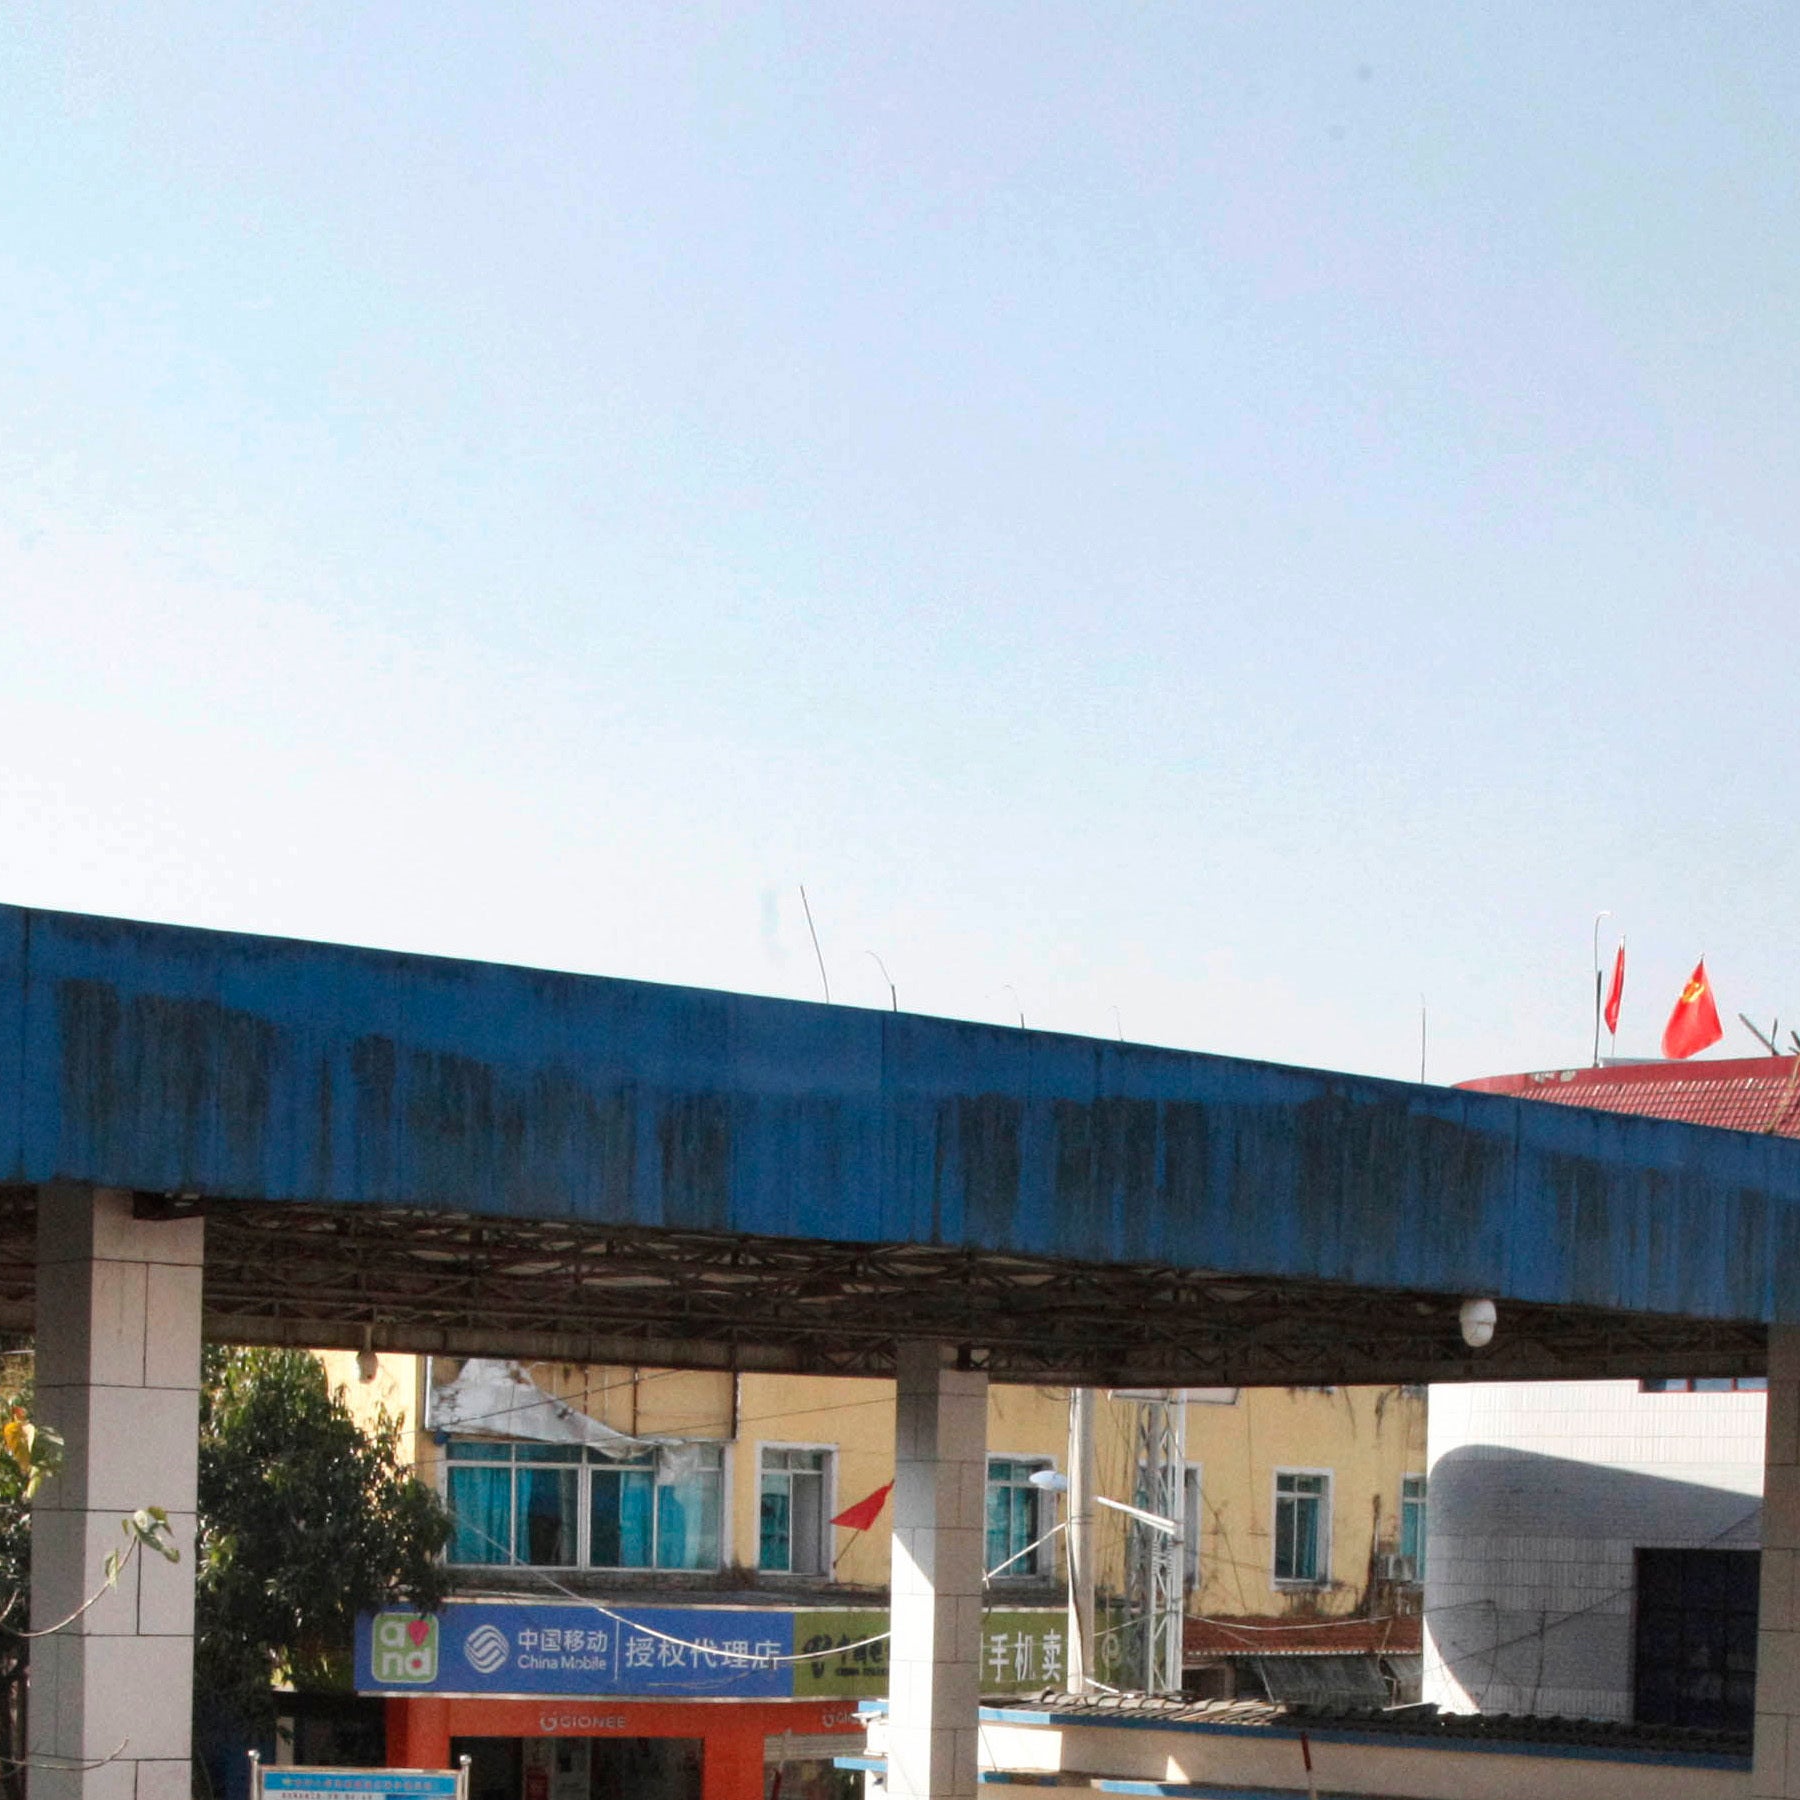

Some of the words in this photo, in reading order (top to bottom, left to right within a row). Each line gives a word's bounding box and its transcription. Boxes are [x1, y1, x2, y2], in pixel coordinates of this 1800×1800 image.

[517, 1628, 608, 1653] 中国移动
[625, 1636, 782, 1670] 授权代理店
[517, 1654, 558, 1670] China
[561, 1656, 606, 1671] Mobile
[988, 1628, 1063, 1683] 手机卖
